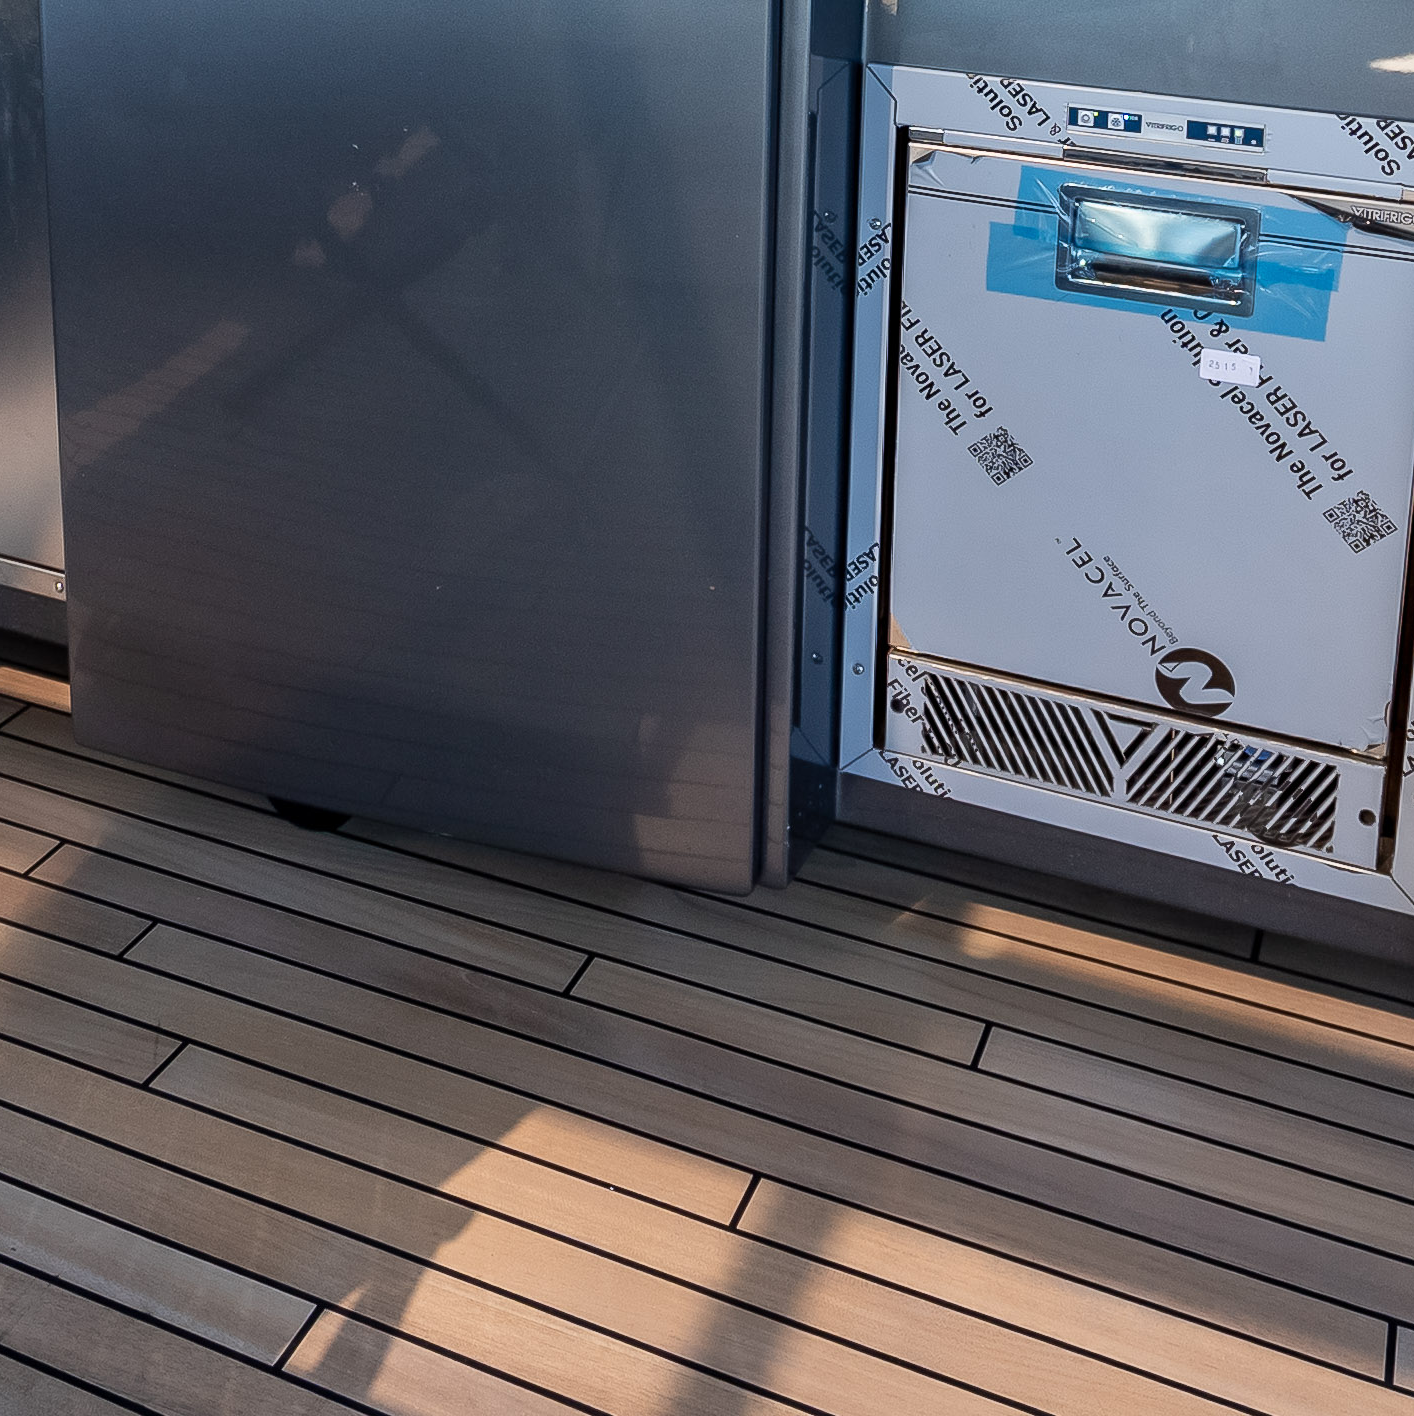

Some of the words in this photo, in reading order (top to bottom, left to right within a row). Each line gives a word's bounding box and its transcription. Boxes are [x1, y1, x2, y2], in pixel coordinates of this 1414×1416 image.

[1145, 121, 1184, 133] VITRIFRIGO
[1209, 318, 1230, 338] &
[914, 328, 971, 391] LASER
[937, 398, 968, 436] The
[964, 389, 994, 419] for
[1265, 385, 1329, 453] LASER
[1219, 385, 1295, 463] Novacel
[1289, 459, 1324, 501] The
[1321, 451, 1354, 482] for
[1102, 554, 1135, 593] Surface
[1065, 536, 1167, 657] NOVACEL
[1132, 591, 1150, 613] The
[1147, 611, 1179, 645] Beyond
